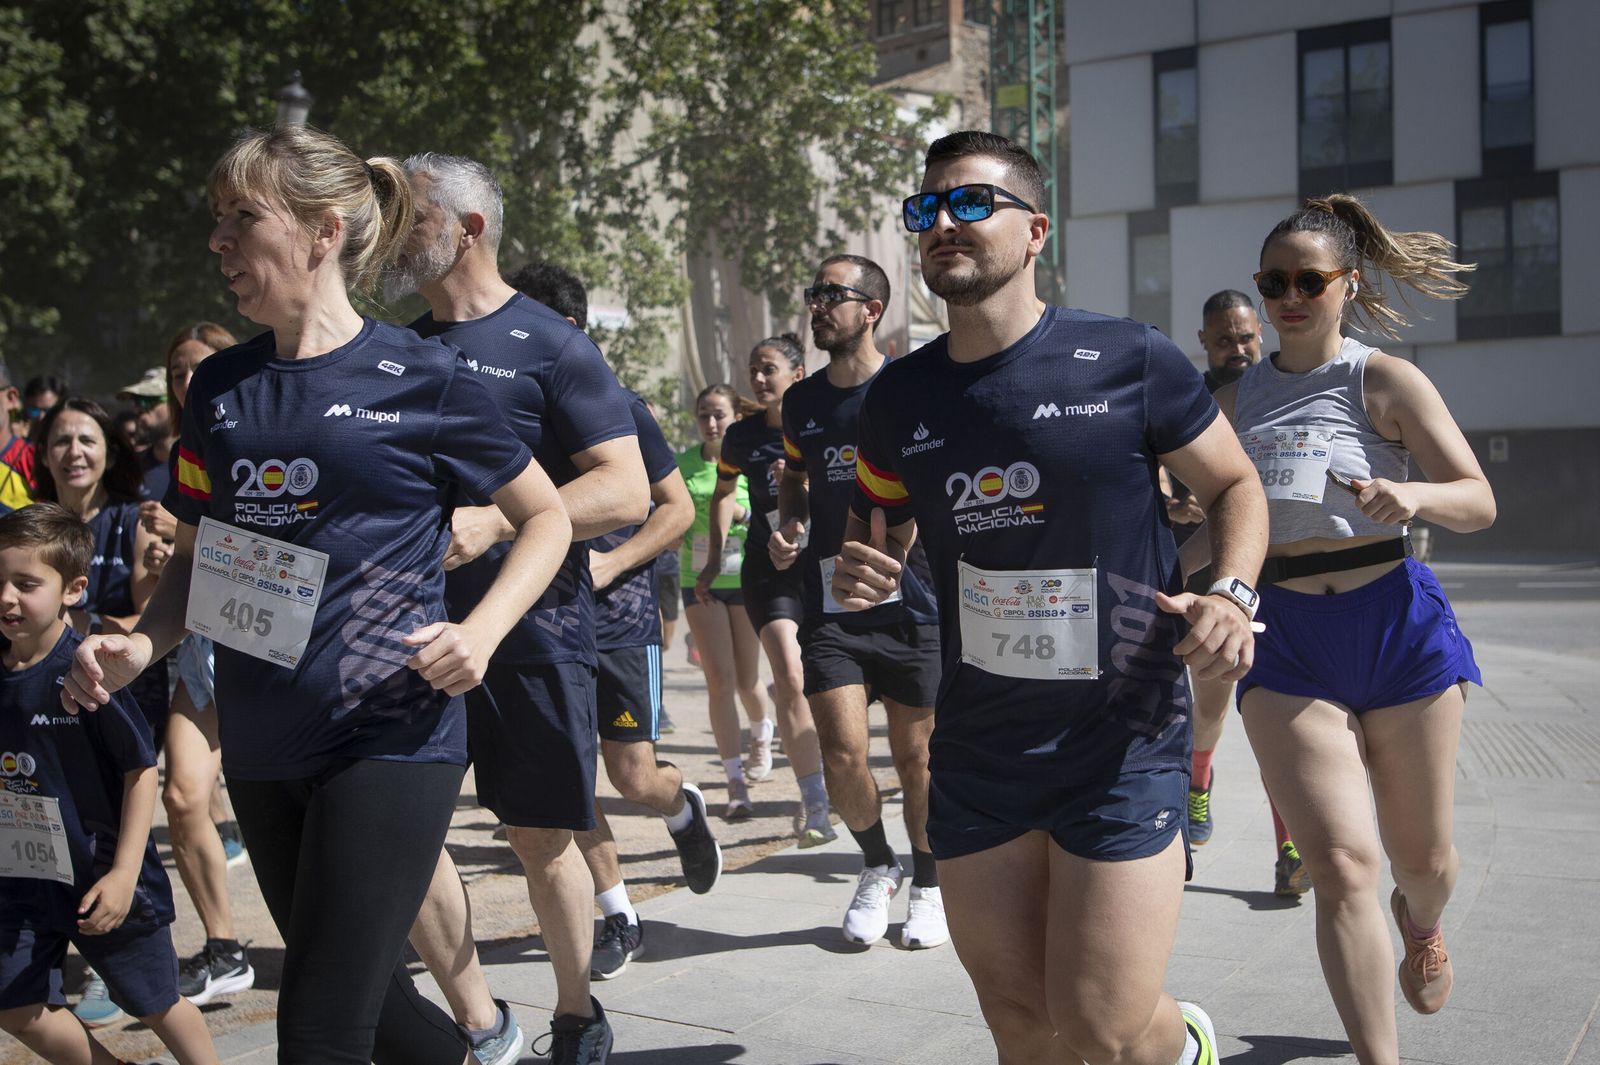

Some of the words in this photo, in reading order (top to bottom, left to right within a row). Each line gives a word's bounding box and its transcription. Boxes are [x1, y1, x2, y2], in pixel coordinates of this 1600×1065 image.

[381, 362, 404, 374] 42K
[481, 365, 516, 379] mupol
[356, 407, 400, 423] mupol
[1065, 400, 1108, 417] mupol
[824, 444, 858, 468] 20
[901, 437, 945, 457] Santander
[231, 457, 319, 497] 200
[945, 461, 1040, 510] 200
[1259, 468, 1295, 486] 88
[234, 503, 298, 515] POLICIA
[234, 511, 317, 527] NACIONAL
[954, 505, 1024, 525] POLICIA
[957, 514, 1045, 535] NACIONAL
[201, 545, 232, 566] alsa
[200, 562, 231, 577] GRANAPOL
[964, 588, 989, 606] alsa
[220, 597, 274, 637] 405
[992, 632, 1056, 660] 748
[11, 840, 59, 865] 1054
